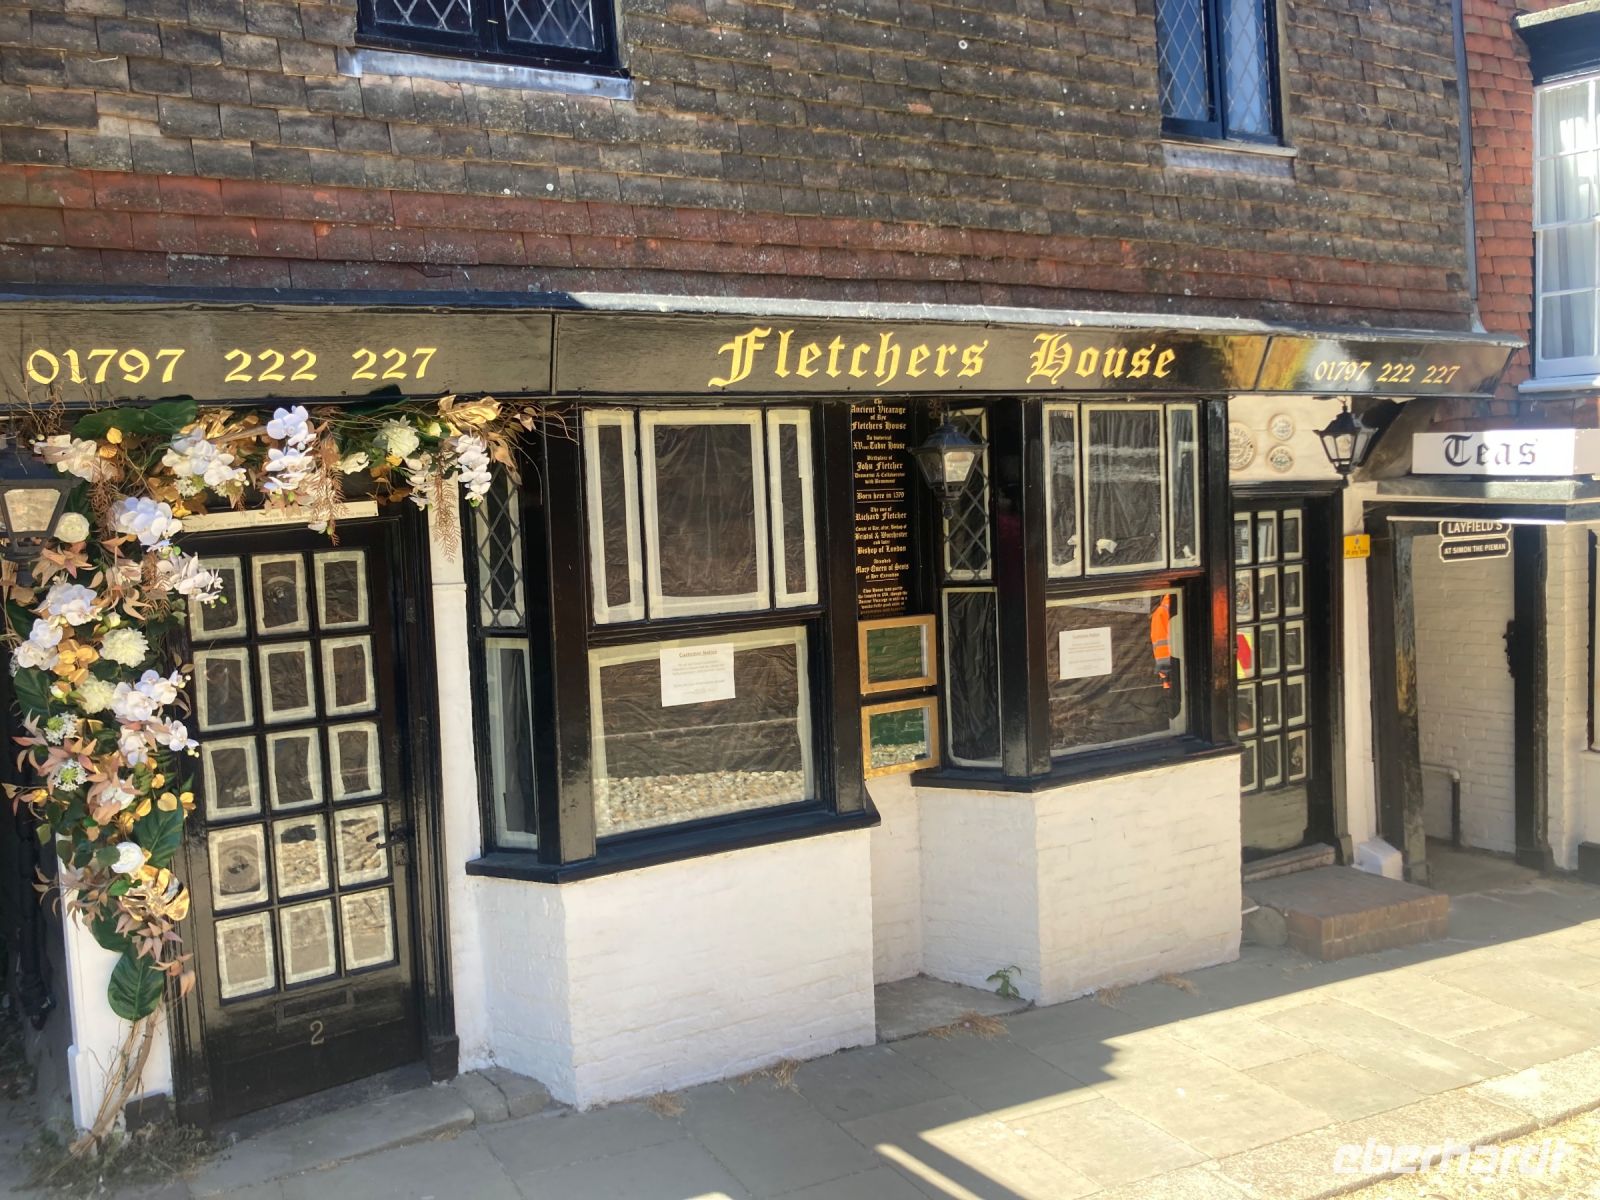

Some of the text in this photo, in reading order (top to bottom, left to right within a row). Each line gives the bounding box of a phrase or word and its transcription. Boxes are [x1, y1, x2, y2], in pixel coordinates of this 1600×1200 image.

[708, 327, 1176, 387] Fletchers House
[26, 347, 438, 385] 01797 222 227
[1314, 361, 1461, 384] 01797 222 227
[851, 404, 906, 415] Ancient Vicarage
[851, 421, 907, 431] Fletchers House
[888, 441, 906, 451] House
[1443, 433, 1539, 467] Teas
[856, 461, 904, 472] John Fletcher
[856, 492, 872, 500] Born
[873, 492, 885, 500] here
[855, 511, 907, 522] Richard Fletcher
[1447, 520, 1503, 534] LAYFIELDS
[857, 546, 878, 555] Bishop
[885, 545, 907, 553] London
[1444, 543, 1506, 555] AT SIMON THE PIEMAN
[855, 565, 870, 574] Mary
[310, 1020, 324, 1046] 2
